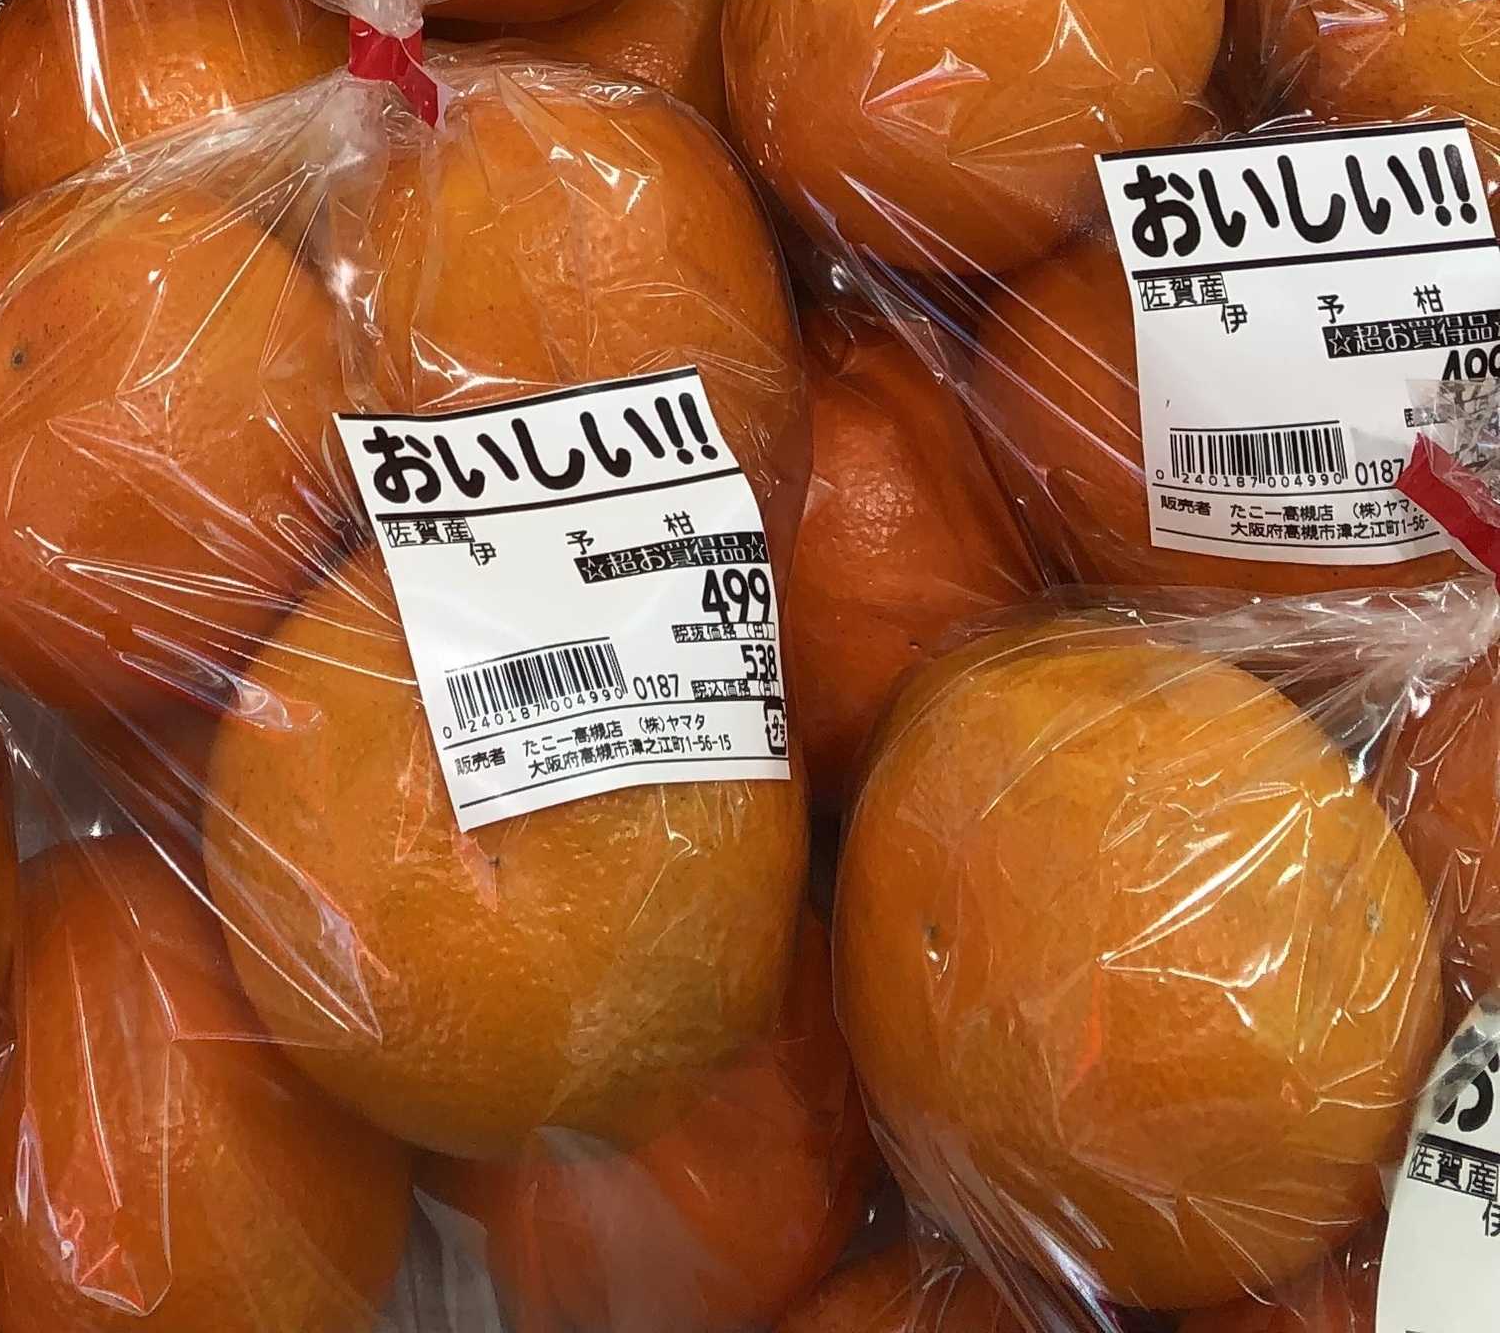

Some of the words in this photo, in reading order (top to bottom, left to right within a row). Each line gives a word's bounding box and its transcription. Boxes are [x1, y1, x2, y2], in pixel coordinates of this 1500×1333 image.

[1124, 143, 1477, 257] おいしい!!
[1139, 275, 1227, 309] 佐賀産
[363, 392, 718, 504] おいしい!!
[1356, 459, 1404, 485] 0187
[1161, 495, 1212, 516] 販売者
[1352, 499, 1418, 519] (株)ヤマ
[383, 517, 474, 547] 佐賀産
[1230, 517, 1430, 540] 大阪府高槻市津之江町1-56-
[702, 568, 771, 624] 499
[741, 645, 777, 680] 538
[633, 674, 679, 700] 0187
[455, 747, 506, 776] 販売者
[1408, 1146, 1498, 1201] 佐賀産
